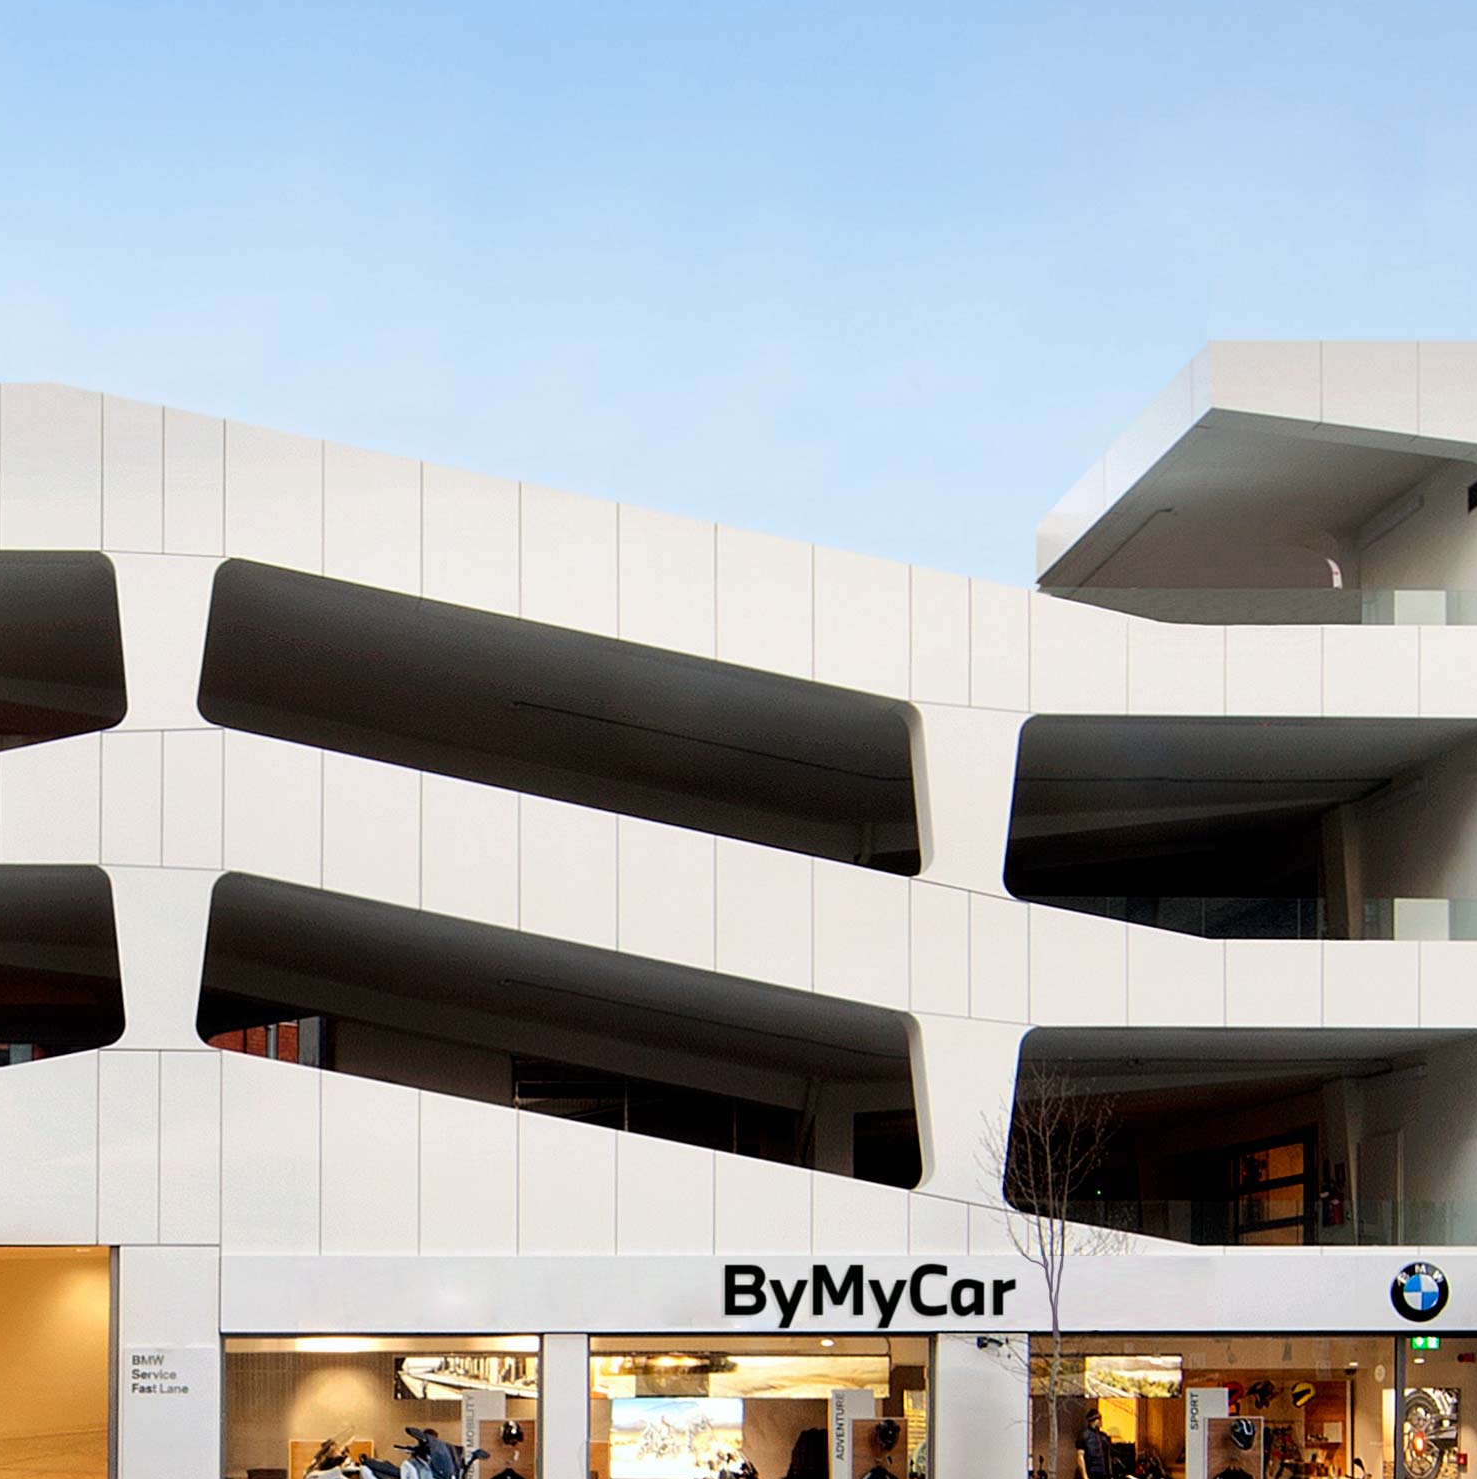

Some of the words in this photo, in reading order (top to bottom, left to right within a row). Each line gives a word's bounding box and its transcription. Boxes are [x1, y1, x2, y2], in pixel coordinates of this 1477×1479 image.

[724, 1264, 1017, 1329] ByMyCar
[131, 1368, 177, 1380] Service
[132, 1354, 165, 1366] BMW
[131, 1382, 157, 1394] Fast
[159, 1382, 189, 1394] Lane
[466, 1393, 475, 1448] MOBILITY
[835, 1391, 845, 1461] ADVENTURE
[1190, 1392, 1199, 1430] SPORT
